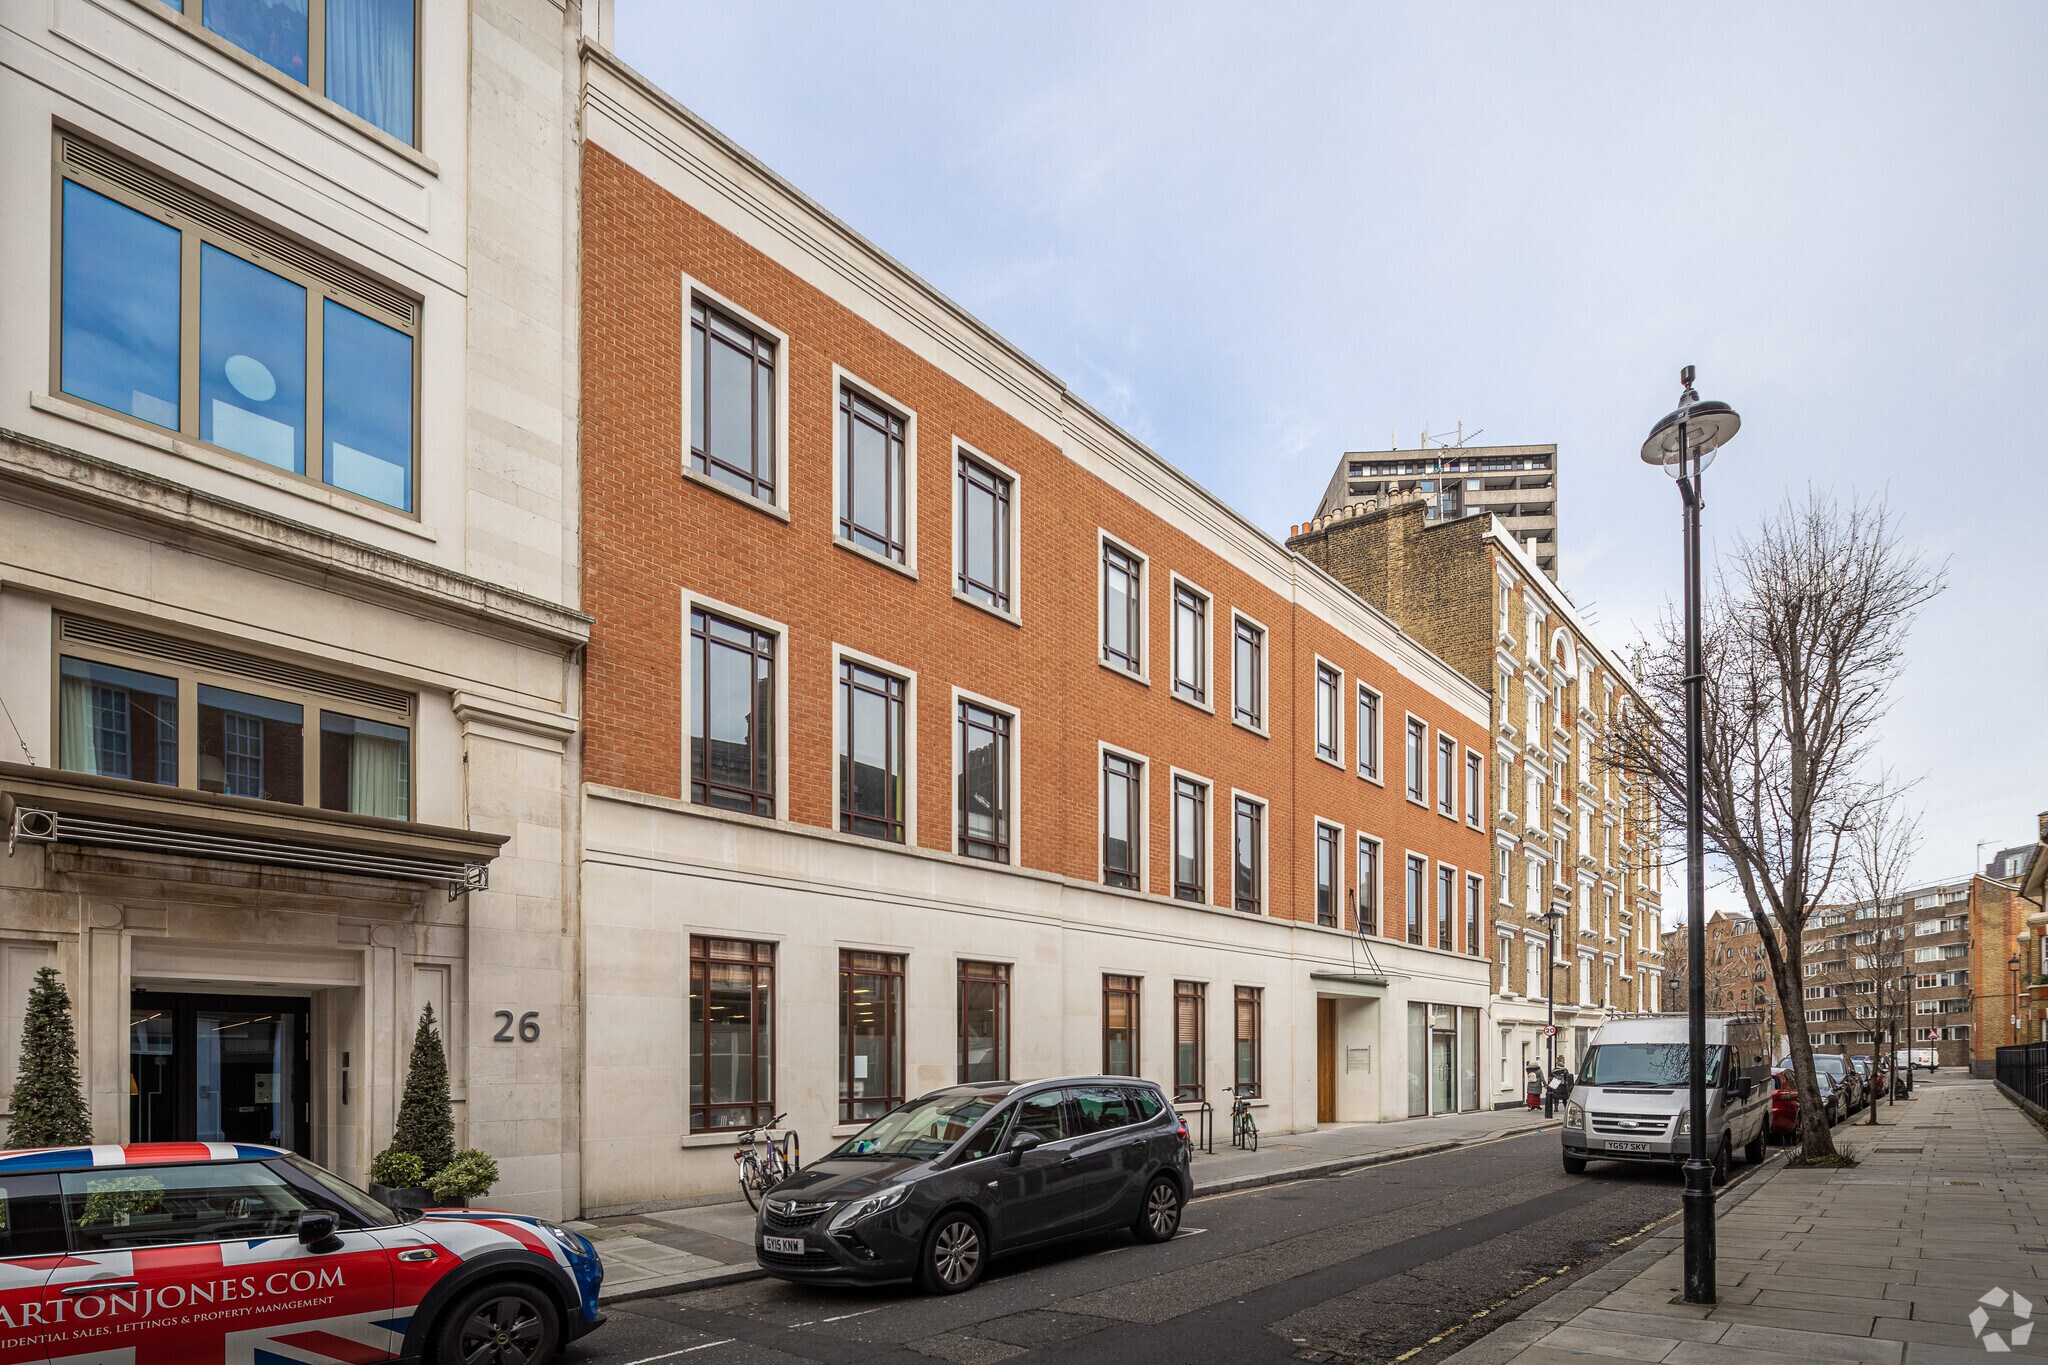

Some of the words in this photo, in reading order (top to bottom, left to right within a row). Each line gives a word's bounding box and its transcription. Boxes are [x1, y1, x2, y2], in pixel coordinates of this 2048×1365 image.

[493, 1010, 540, 1042] 26
[1608, 1142, 1629, 1150] YG57
[766, 1238, 781, 1251] GY15
[782, 1239, 799, 1252] KNW
[0, 1266, 346, 1329] ARTONJONES.COM
[116, 1316, 178, 1333] LETTINGS
[180, 1315, 190, 1325] &
[193, 1306, 253, 1323] PROPERTY
[255, 1295, 335, 1314] MANAGEMENT
